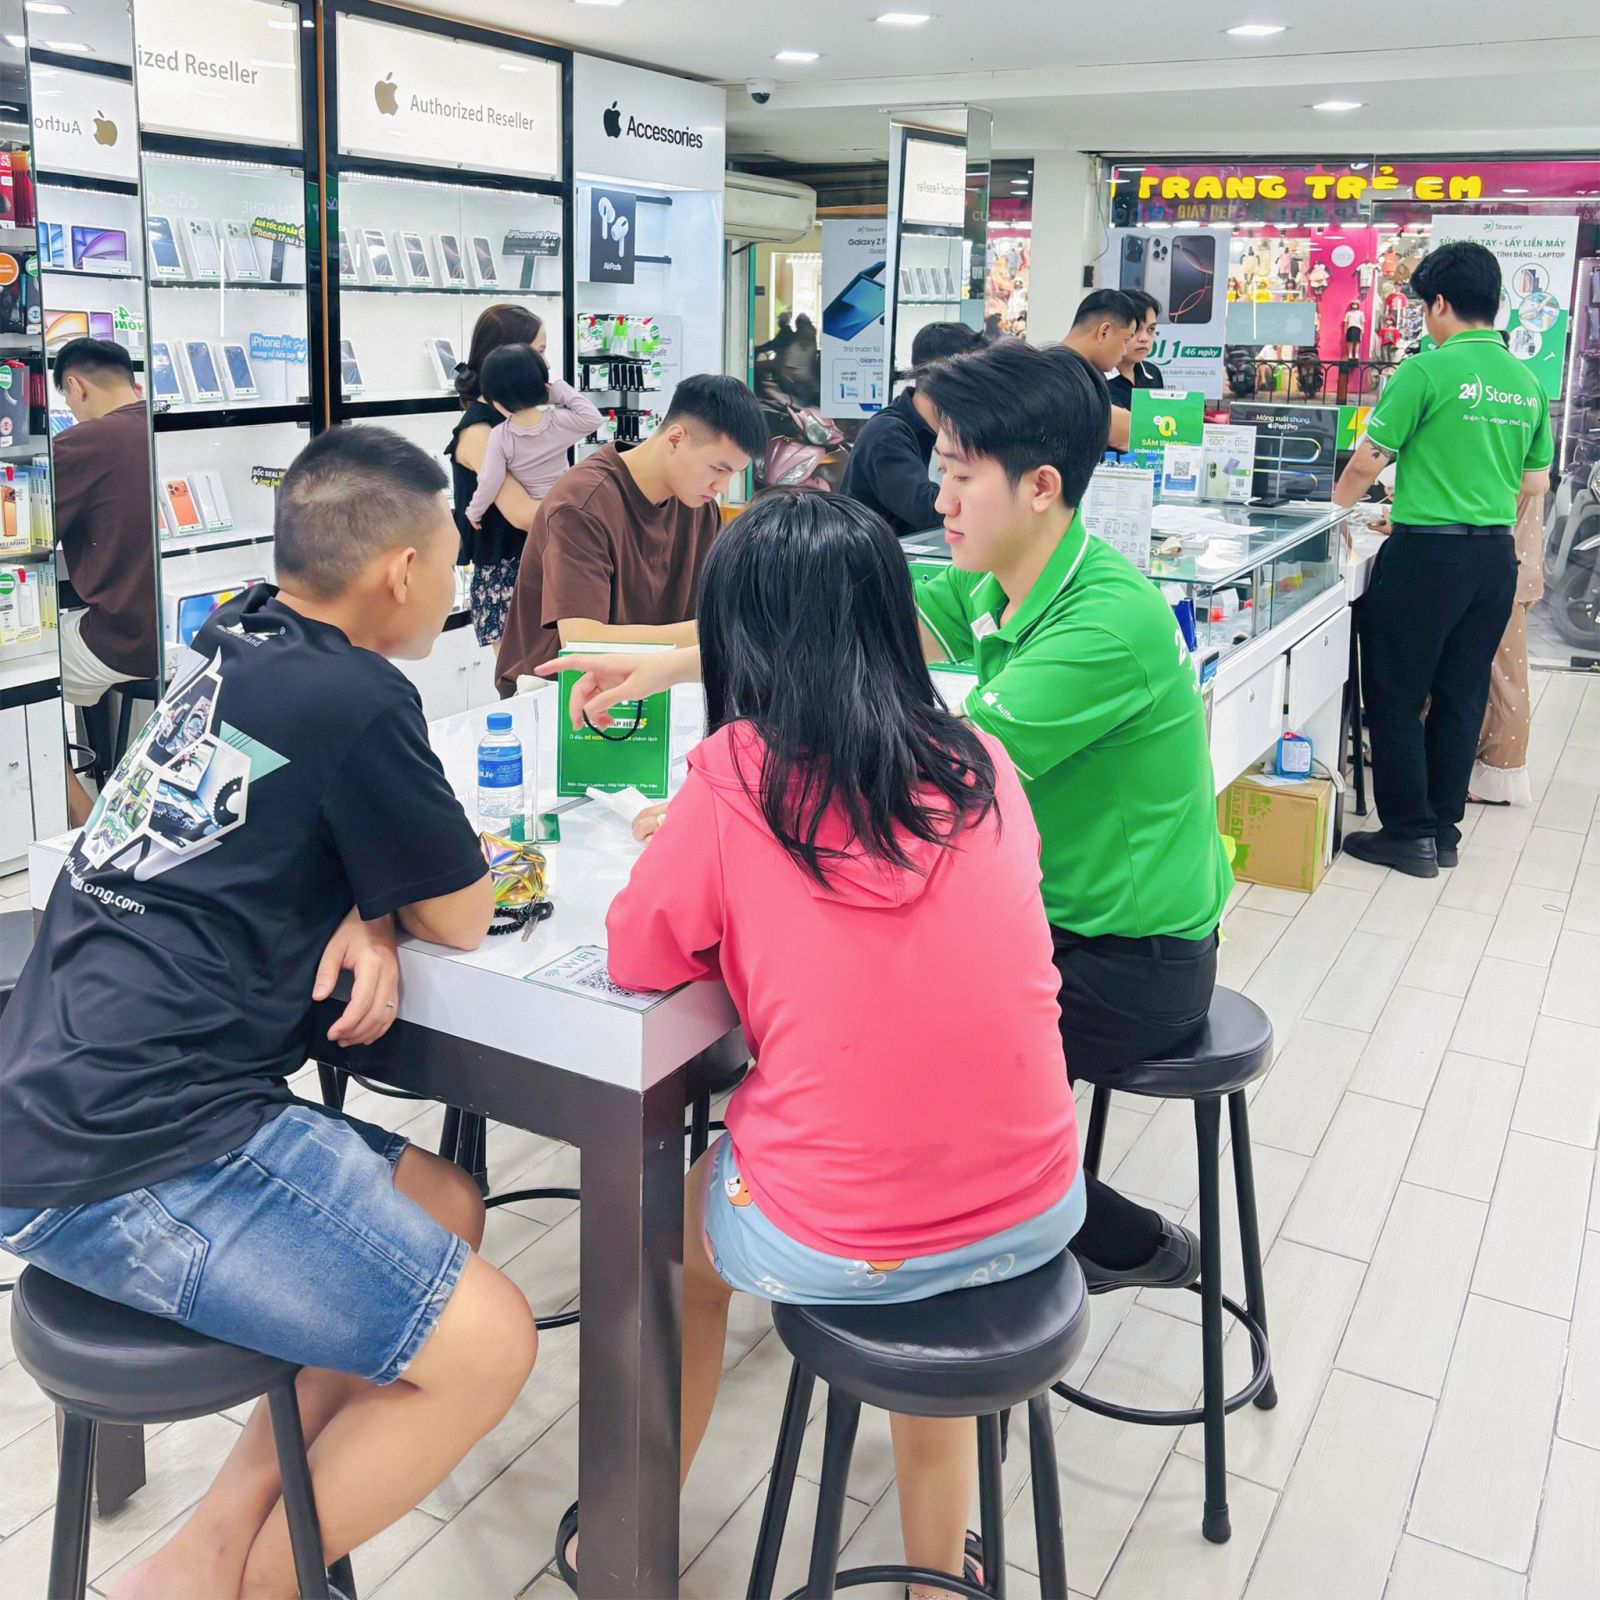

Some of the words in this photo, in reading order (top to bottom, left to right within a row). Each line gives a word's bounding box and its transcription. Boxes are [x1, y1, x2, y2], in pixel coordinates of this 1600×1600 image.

[185, 53, 258, 85] Reseller
[410, 94, 484, 122] Authorized
[487, 107, 534, 131] Reseller
[626, 115, 703, 149] Accessories
[1138, 175, 1287, 200] TRANG
[1415, 175, 1482, 200] EM
[251, 227, 277, 240] iPhone
[278, 233, 286, 241] 17
[508, 231, 534, 239] iPhone
[544, 232, 558, 240] Pro
[848, 238, 876, 246] Galaxy
[603, 262, 622, 271] AirPods
[251, 336, 280, 348] iPhone
[1458, 383, 1477, 400] 24
[1485, 385, 1538, 408] Store.vn
[557, 951, 597, 969] WIFI
